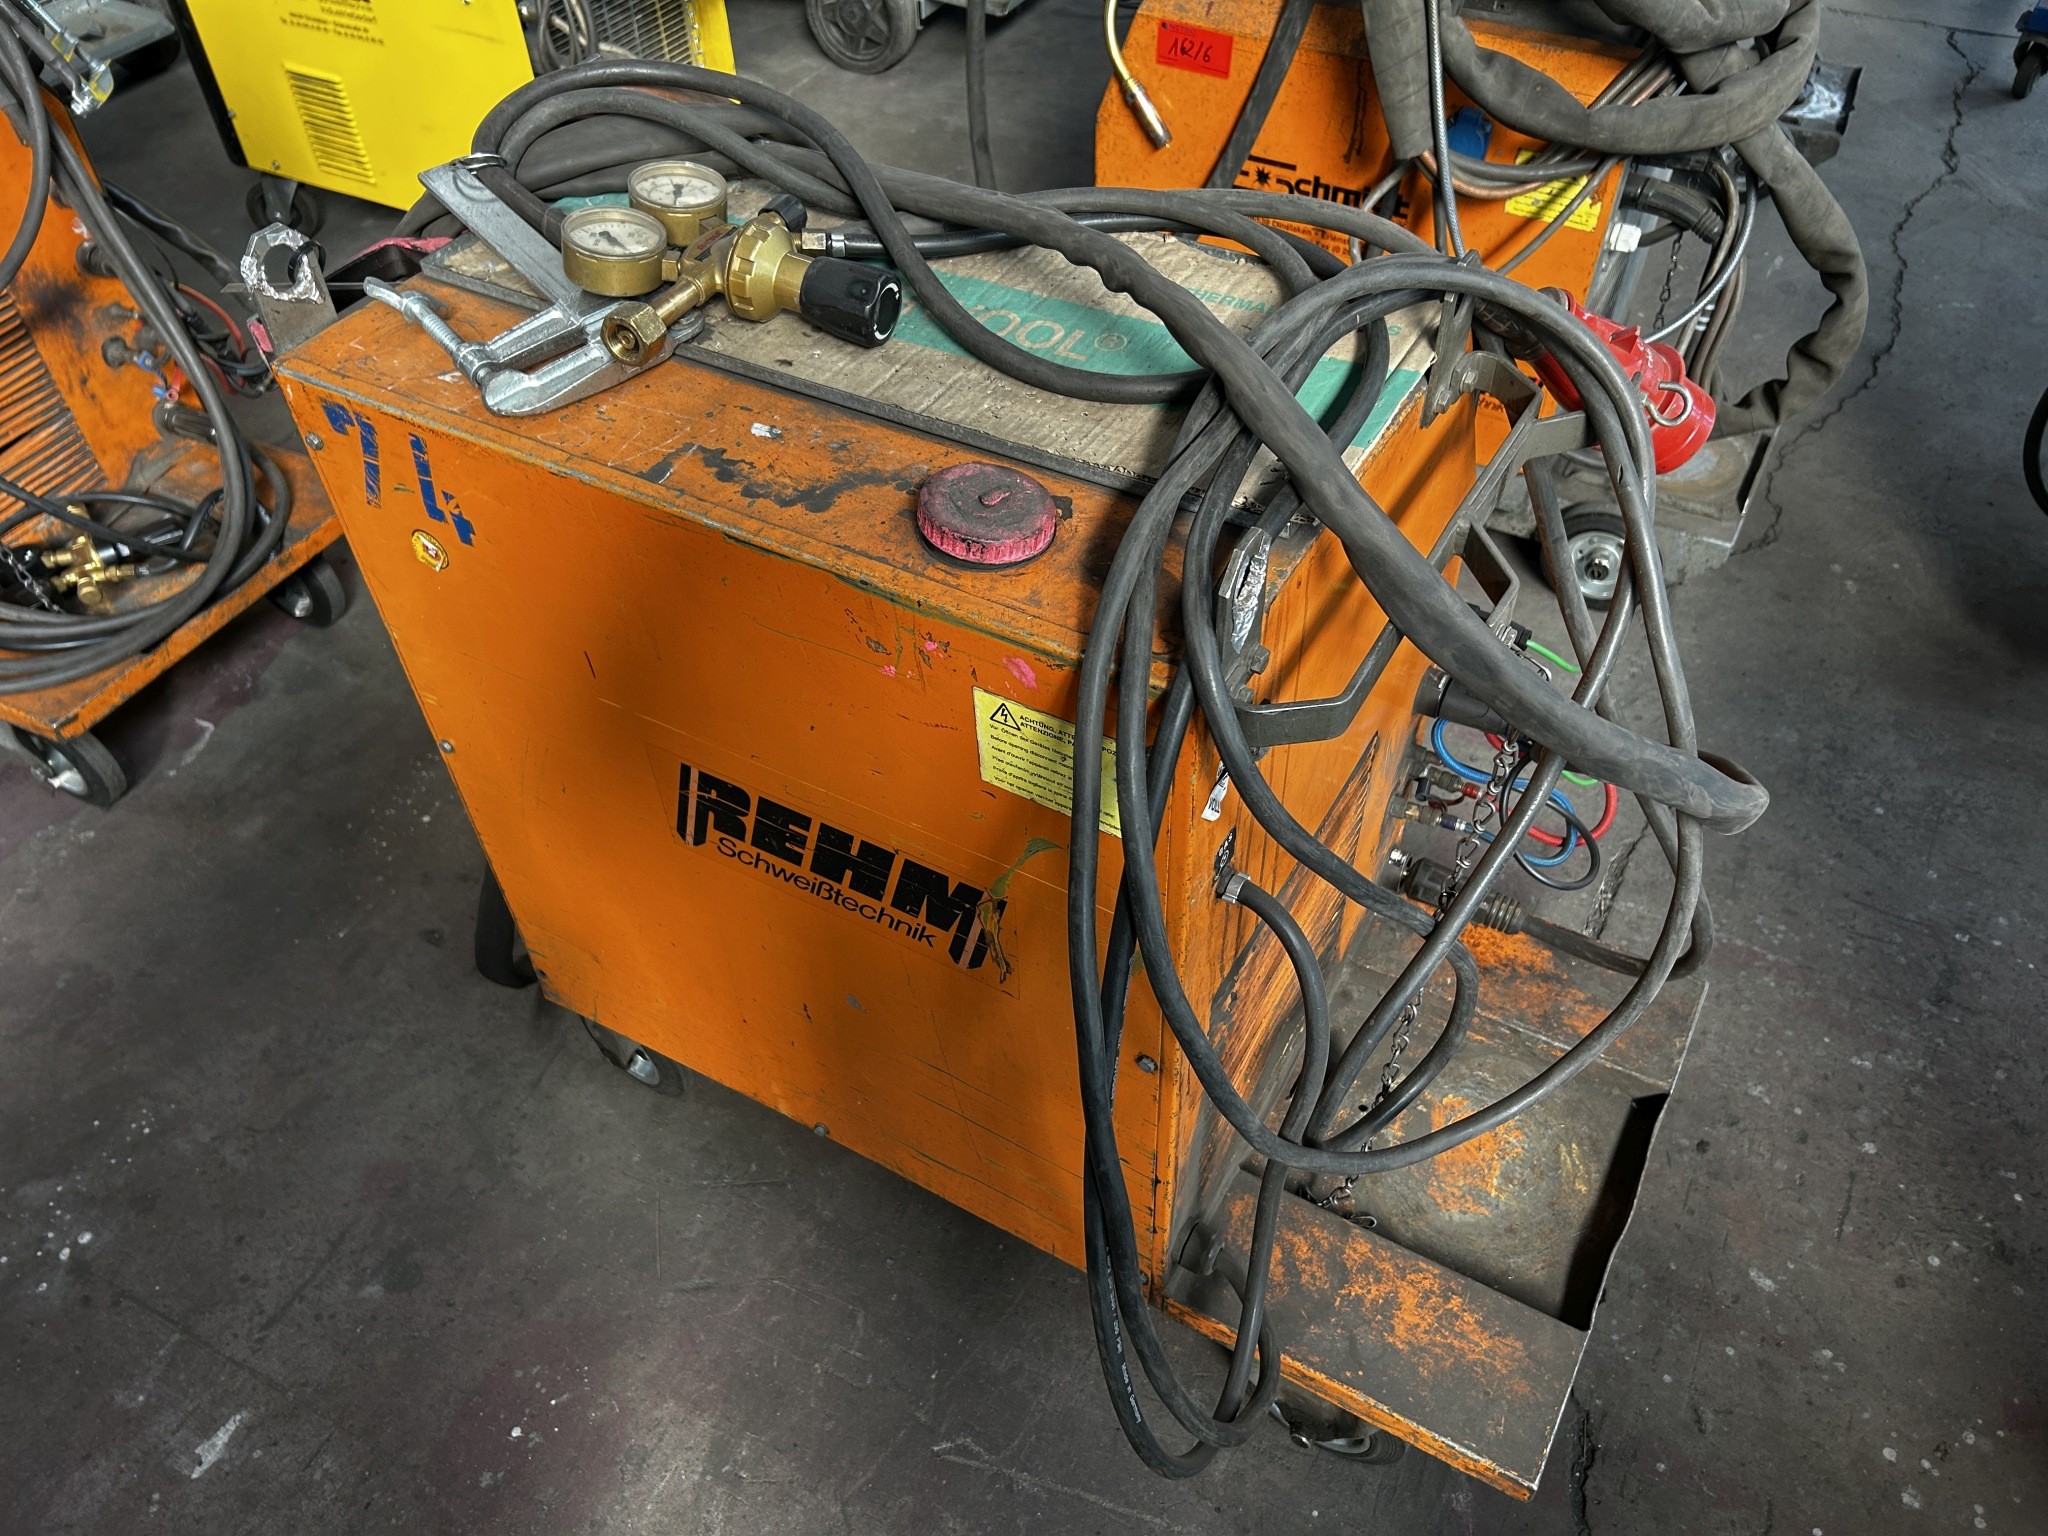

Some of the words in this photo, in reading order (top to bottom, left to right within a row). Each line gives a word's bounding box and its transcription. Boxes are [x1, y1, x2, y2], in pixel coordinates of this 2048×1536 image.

[1184, 286, 1275, 314] HERMAL
[676, 762, 1008, 969] REHM
[717, 836, 937, 948] Schweißtechnik
